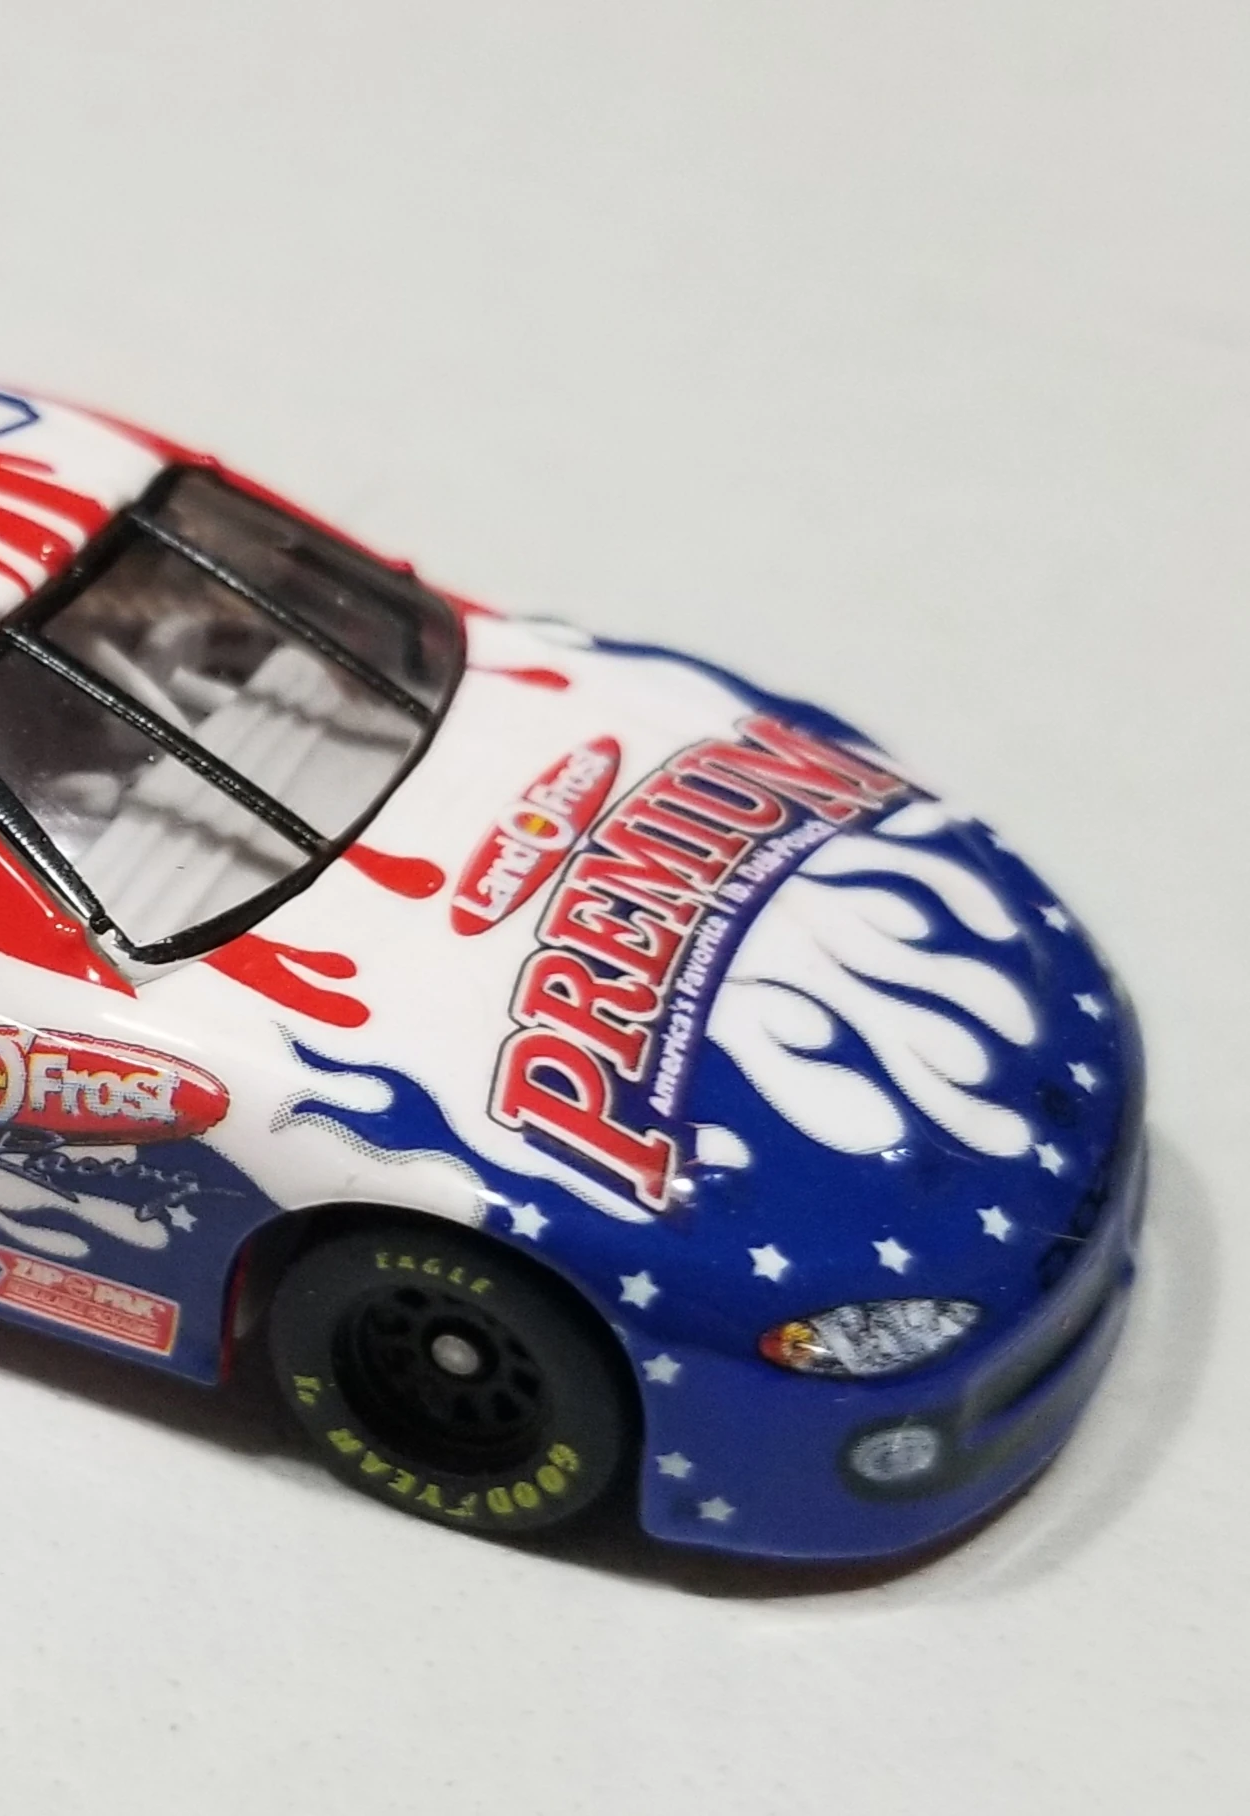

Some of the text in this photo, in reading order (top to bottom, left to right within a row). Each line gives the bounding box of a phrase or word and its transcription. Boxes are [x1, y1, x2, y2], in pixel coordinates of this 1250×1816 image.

[488, 717, 910, 1214] PREMIUM
[648, 997, 695, 1118] America's
[675, 914, 729, 998] Favorite
[374, 1250, 495, 1294] EAGLE
